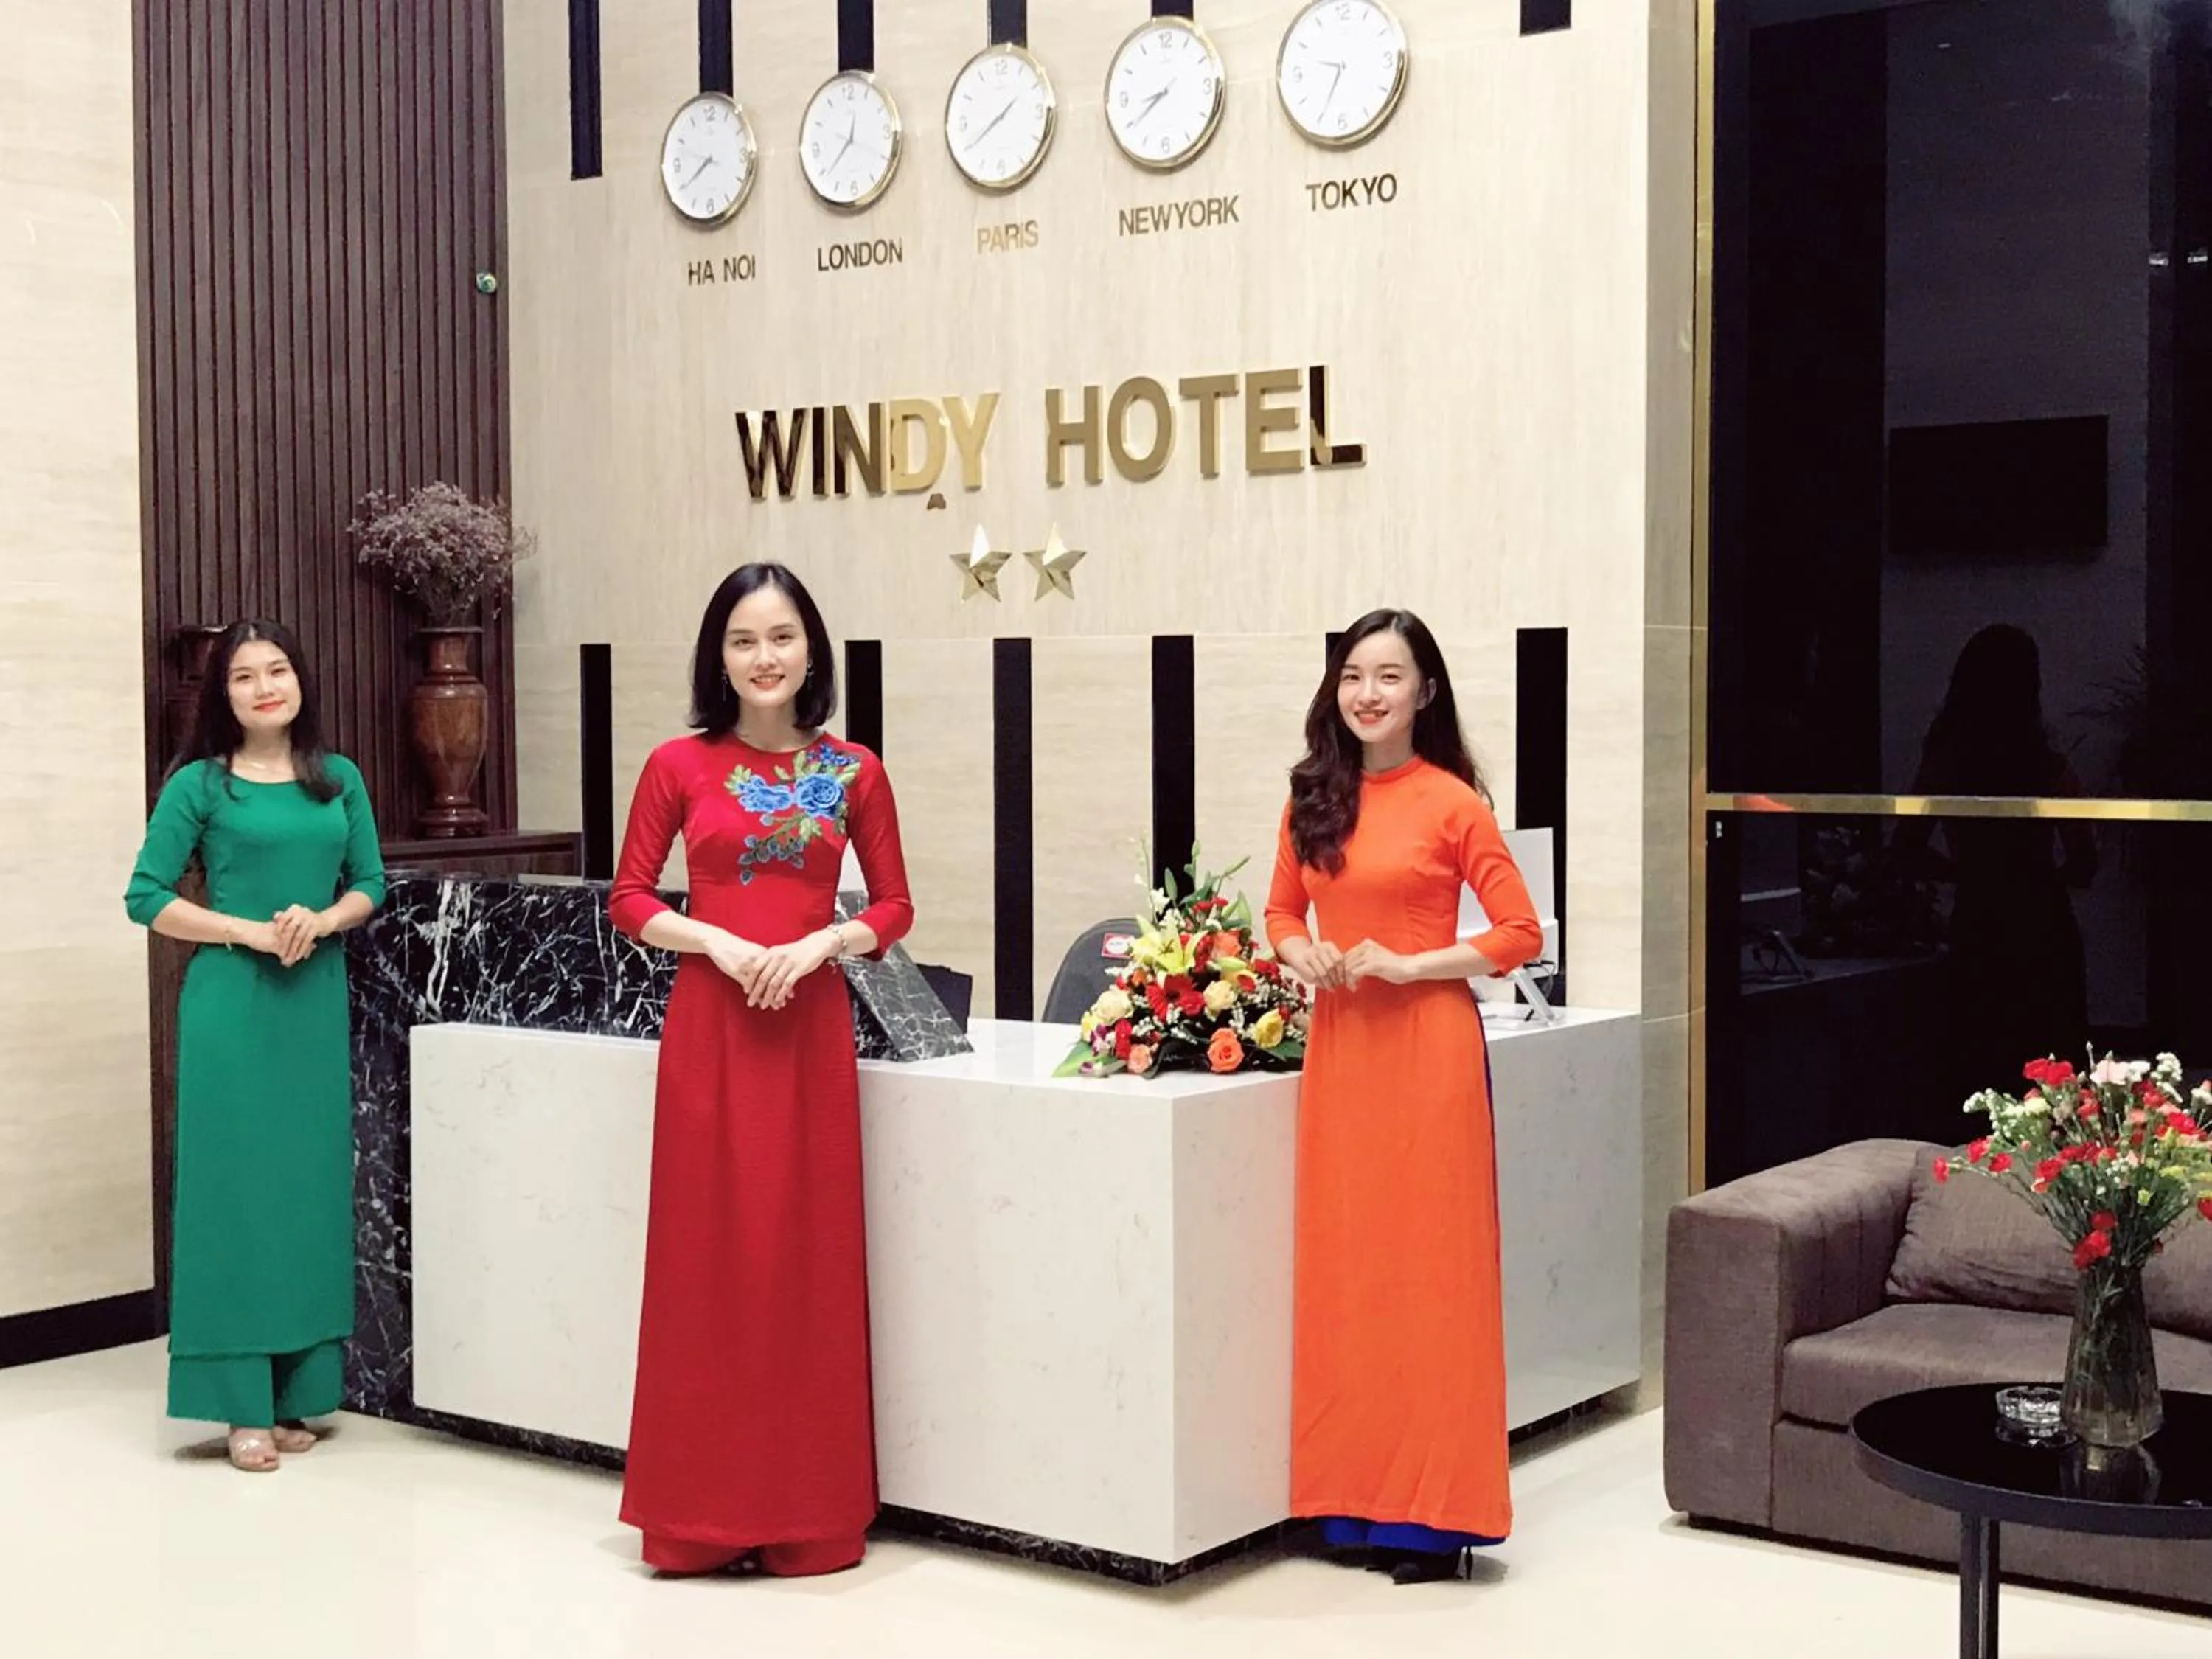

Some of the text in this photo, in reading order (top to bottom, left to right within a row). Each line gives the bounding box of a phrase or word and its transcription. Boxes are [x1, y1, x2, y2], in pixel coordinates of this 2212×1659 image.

[1335, 3, 1351, 21] 12
[1158, 31, 1173, 48] 12
[1382, 50, 1393, 69] 3
[841, 83, 855, 100] 12
[1203, 77, 1212, 95] 3
[1119, 91, 1129, 108] 9
[703, 105, 717, 122] 12
[1034, 103, 1043, 120] 3
[1337, 112, 1348, 131] 6
[1161, 136, 1171, 154] 6
[850, 180, 858, 197] 6
[1305, 173, 1397, 212] TOKYO
[706, 198, 714, 214] 6
[1119, 195, 1240, 237] NEWYORK
[977, 220, 1039, 254] PARIS
[817, 237, 903, 272] LONDON
[687, 254, 757, 286] HA NOI
[735, 364, 1368, 499] WINDY HOTEL
